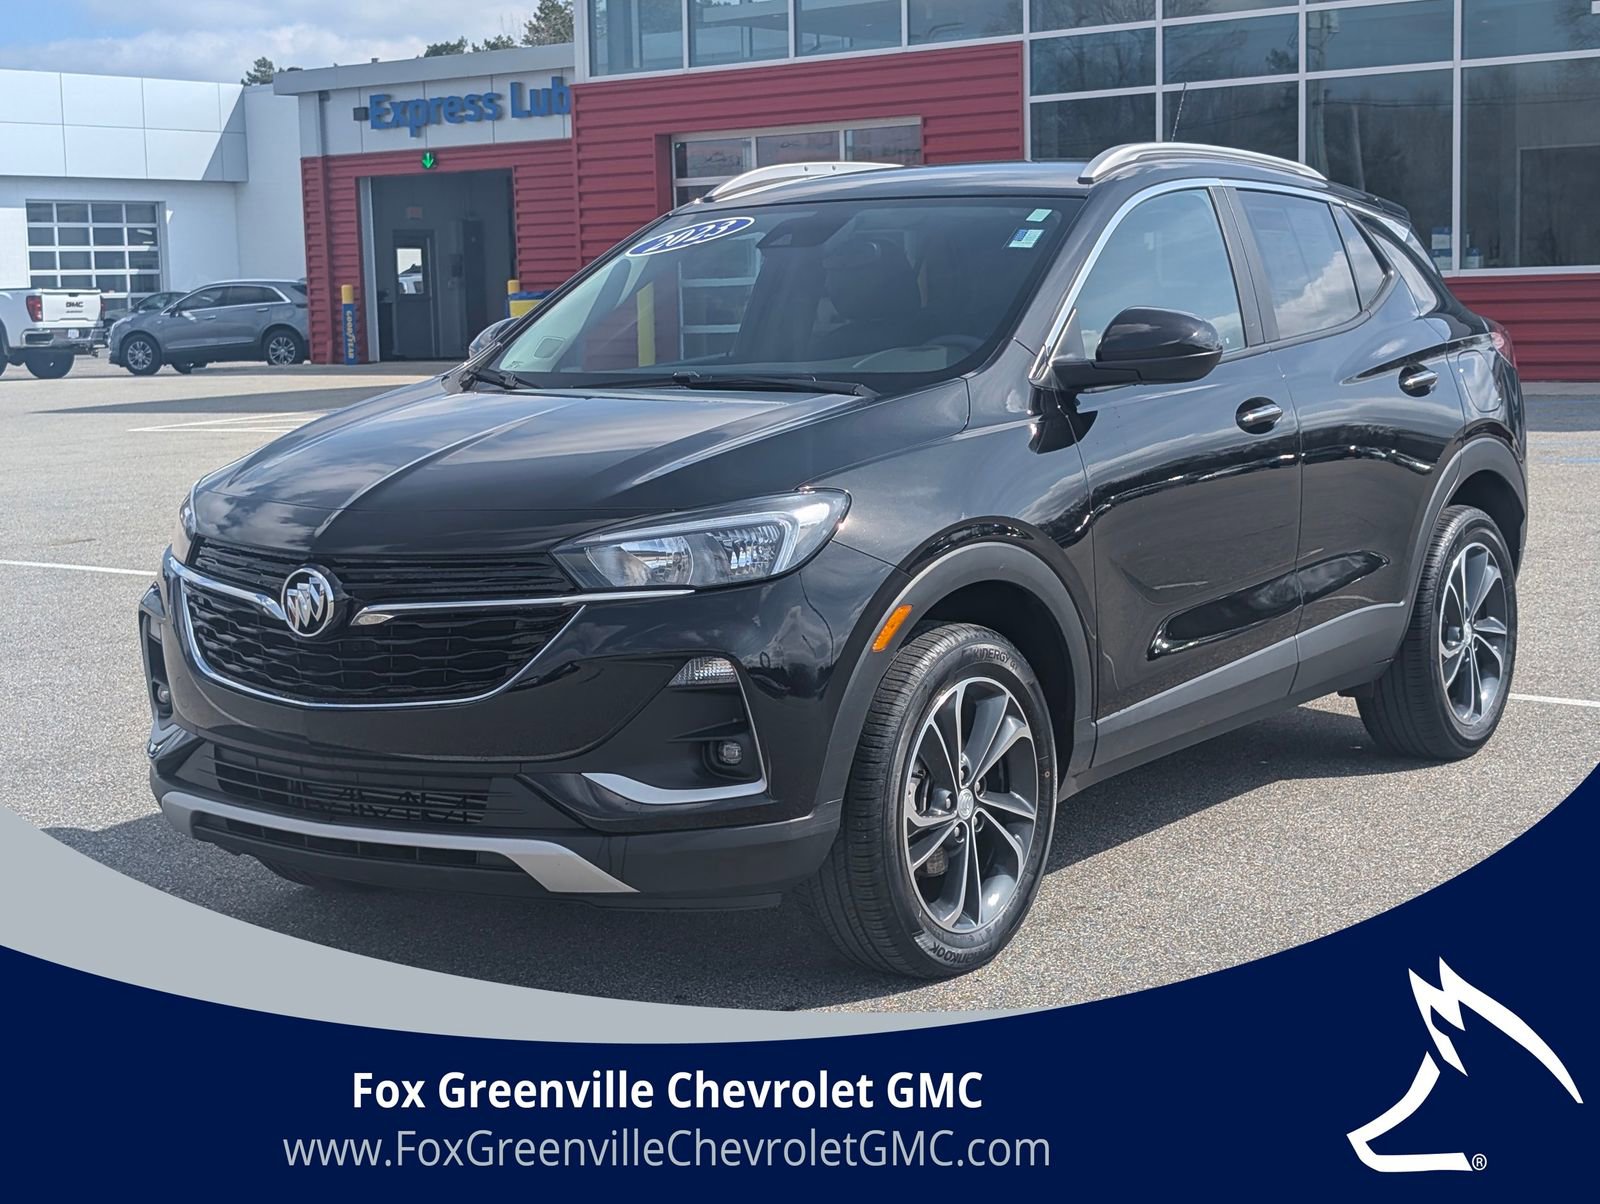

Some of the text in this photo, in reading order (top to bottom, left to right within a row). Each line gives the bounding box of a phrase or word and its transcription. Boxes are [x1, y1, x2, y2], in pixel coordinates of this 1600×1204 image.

[369, 92, 503, 138] Express
[642, 219, 737, 254] 2023
[346, 310, 356, 359] GOODYEAR
